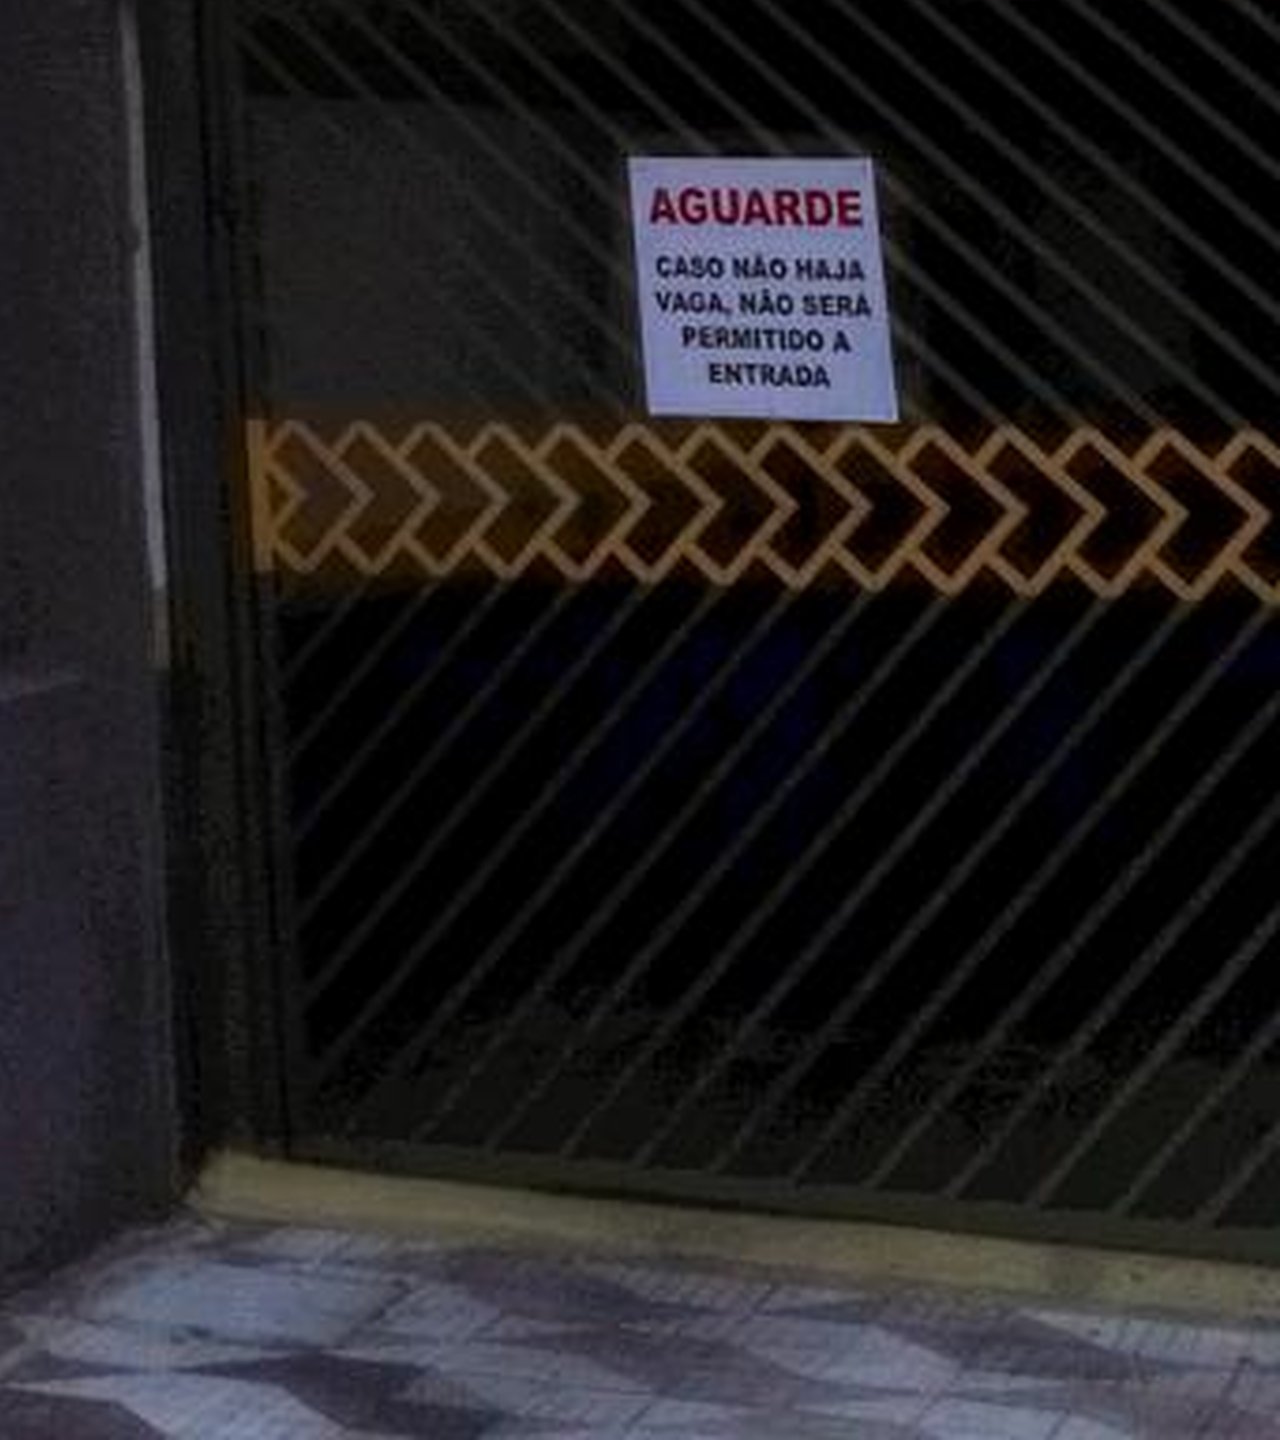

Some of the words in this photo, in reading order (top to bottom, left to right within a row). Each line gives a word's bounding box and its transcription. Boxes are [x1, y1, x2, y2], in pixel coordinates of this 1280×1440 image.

[649, 187, 864, 228] AGUARDE
[655, 255, 725, 280] CASO
[733, 254, 787, 281] NÃO
[795, 258, 865, 281] HAJA
[655, 291, 731, 316] VAGA,
[740, 288, 794, 316] NÃO
[682, 326, 824, 352] PERMITIDO
[832, 331, 851, 353] A
[708, 362, 831, 388] ENTRADA
